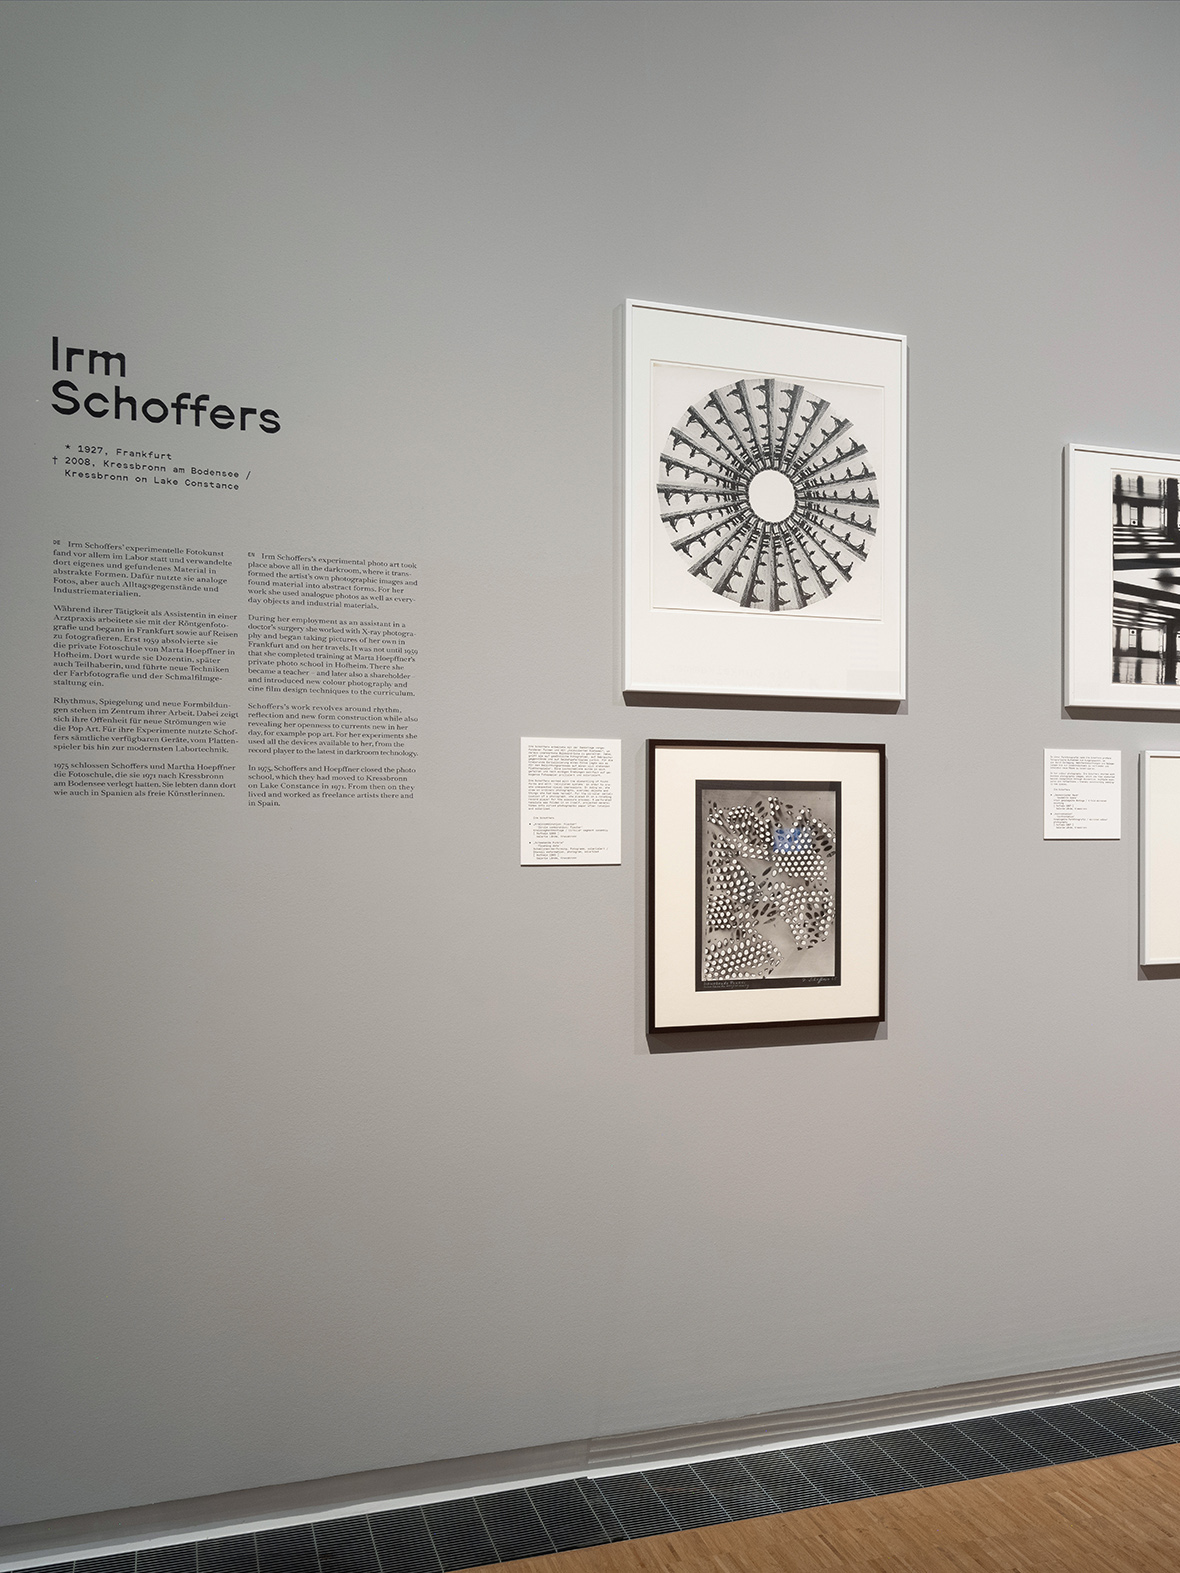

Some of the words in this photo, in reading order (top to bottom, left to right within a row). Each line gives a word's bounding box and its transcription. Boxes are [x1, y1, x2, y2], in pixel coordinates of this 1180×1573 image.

[52, 336, 126, 377] Irm
[52, 380, 281, 434] Schoffers
[78, 445, 109, 456] 1927,
[116, 448, 172, 460] Frankfurt
[65, 456, 95, 467] 2008,
[104, 460, 166, 472] Kressbronn
[192, 467, 239, 478] Bodensee
[65, 470, 129, 481] Kressbronn
[154, 476, 178, 485] Lake
[185, 479, 239, 490] Constance
[125, 544, 184, 555] experimentelle
[185, 548, 223, 556] Fotokunst
[186, 557, 232, 565] verwandelte
[247, 561, 267, 570] place
[72, 560, 104, 569] eigenes
[124, 562, 171, 573] gefundenes
[52, 568, 92, 576] abstrakte
[196, 575, 227, 585] analoge
[262, 597, 289, 606] objects
[248, 614, 275, 623] During
[291, 616, 337, 626] employment
[52, 624, 76, 633] grafie
[96, 626, 125, 635] begann
[68, 642, 97, 651] private
[186, 646, 226, 656] Hoepffner
[70, 670, 129, 680] Farbfotografie
[53, 679, 87, 688] staltung
[347, 680, 392, 689] photography
[282, 686, 308, 695] design
[309, 687, 349, 696] techniques
[163, 718, 211, 727] Strömungen
[275, 730, 306, 738] example
[361, 731, 404, 740] experiments
[53, 743, 81, 752] spieler
[196, 764, 235, 772] Hoepffner
[298, 774, 315, 782] they
[100, 790, 132, 798] Spanien
